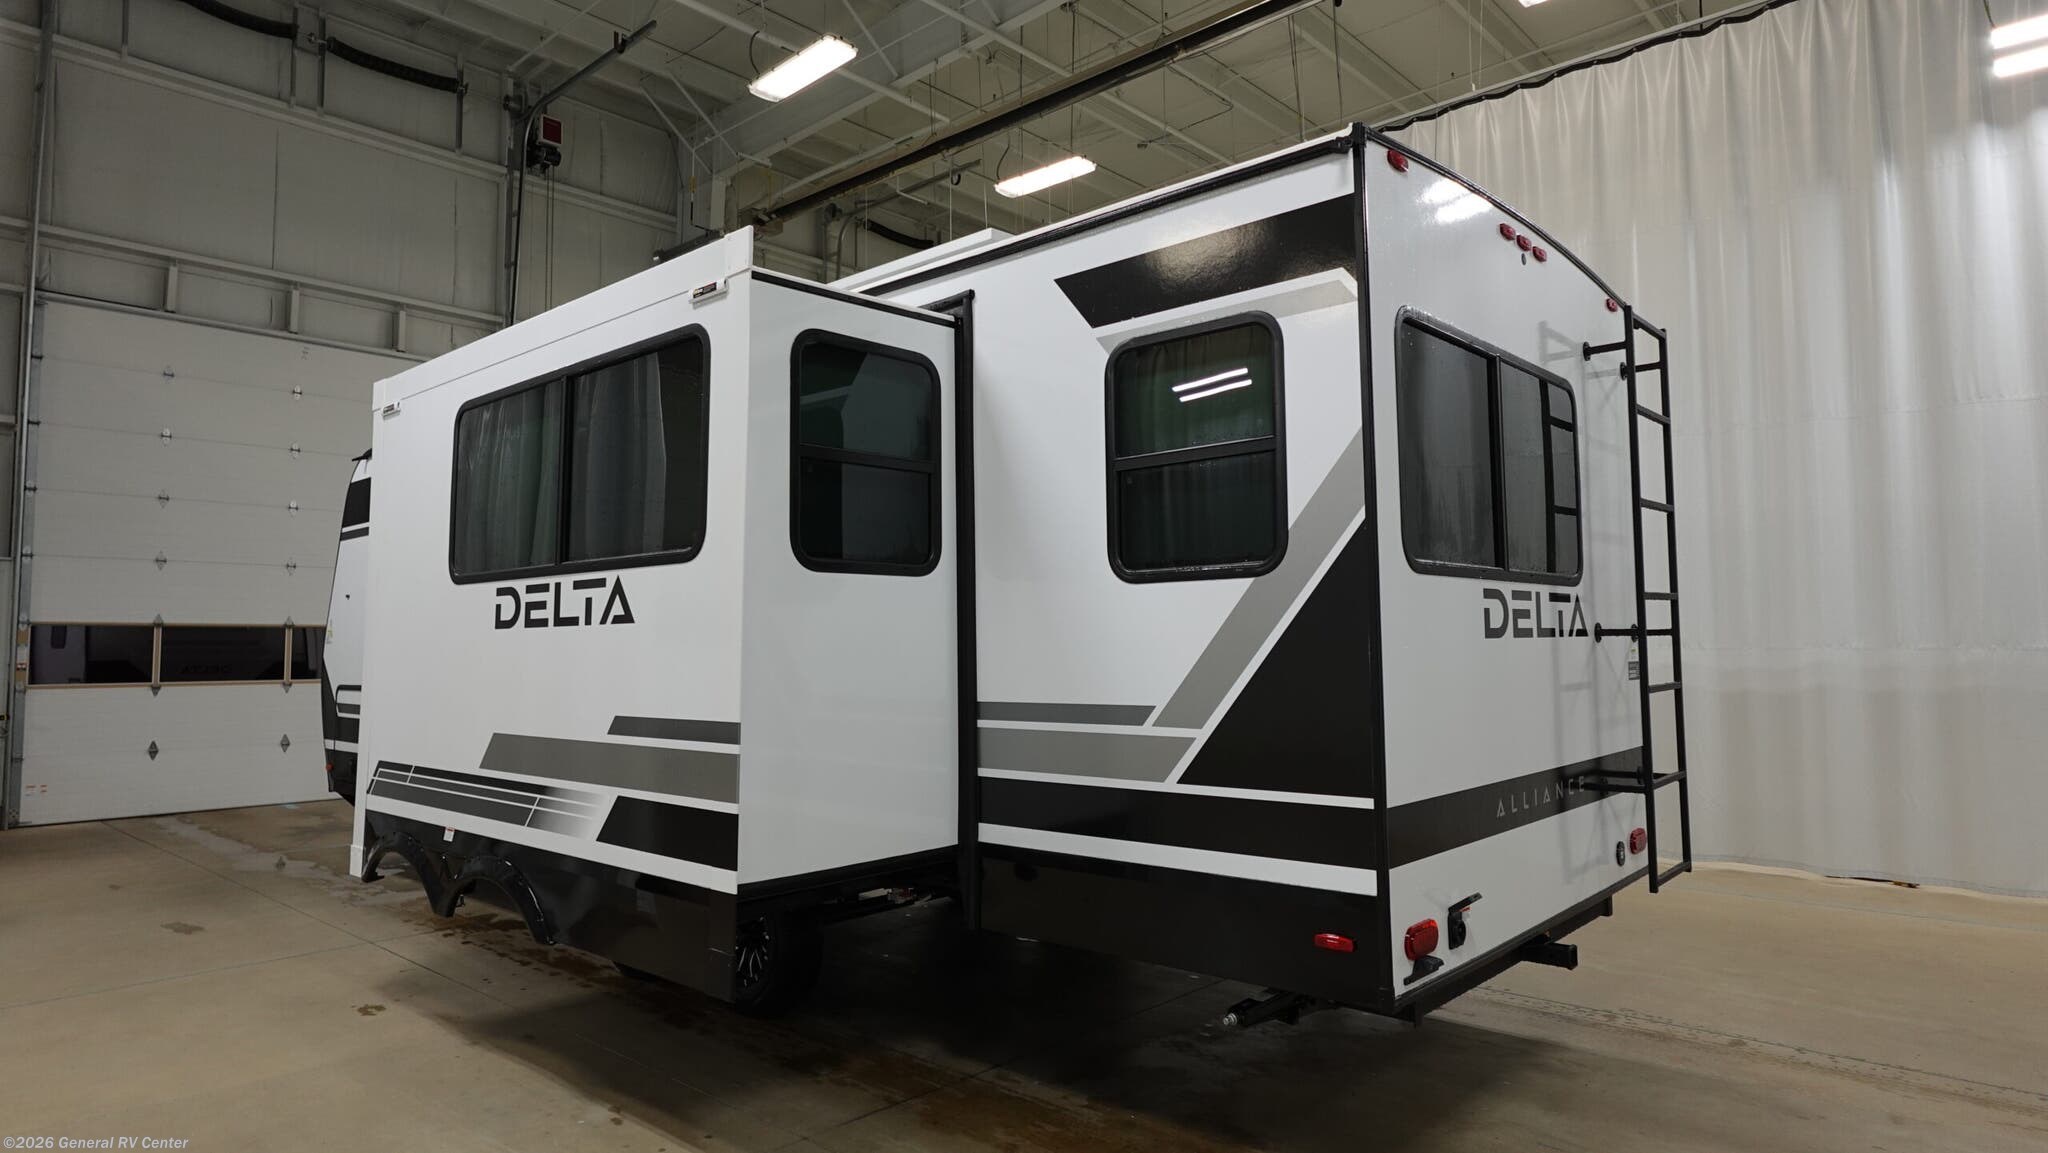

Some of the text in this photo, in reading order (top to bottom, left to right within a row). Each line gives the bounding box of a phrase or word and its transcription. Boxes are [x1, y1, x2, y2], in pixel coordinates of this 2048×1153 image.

[495, 574, 635, 630] DELTA
[1483, 588, 1589, 639] DELTA
[1497, 775, 1585, 818] ALLIANCE
